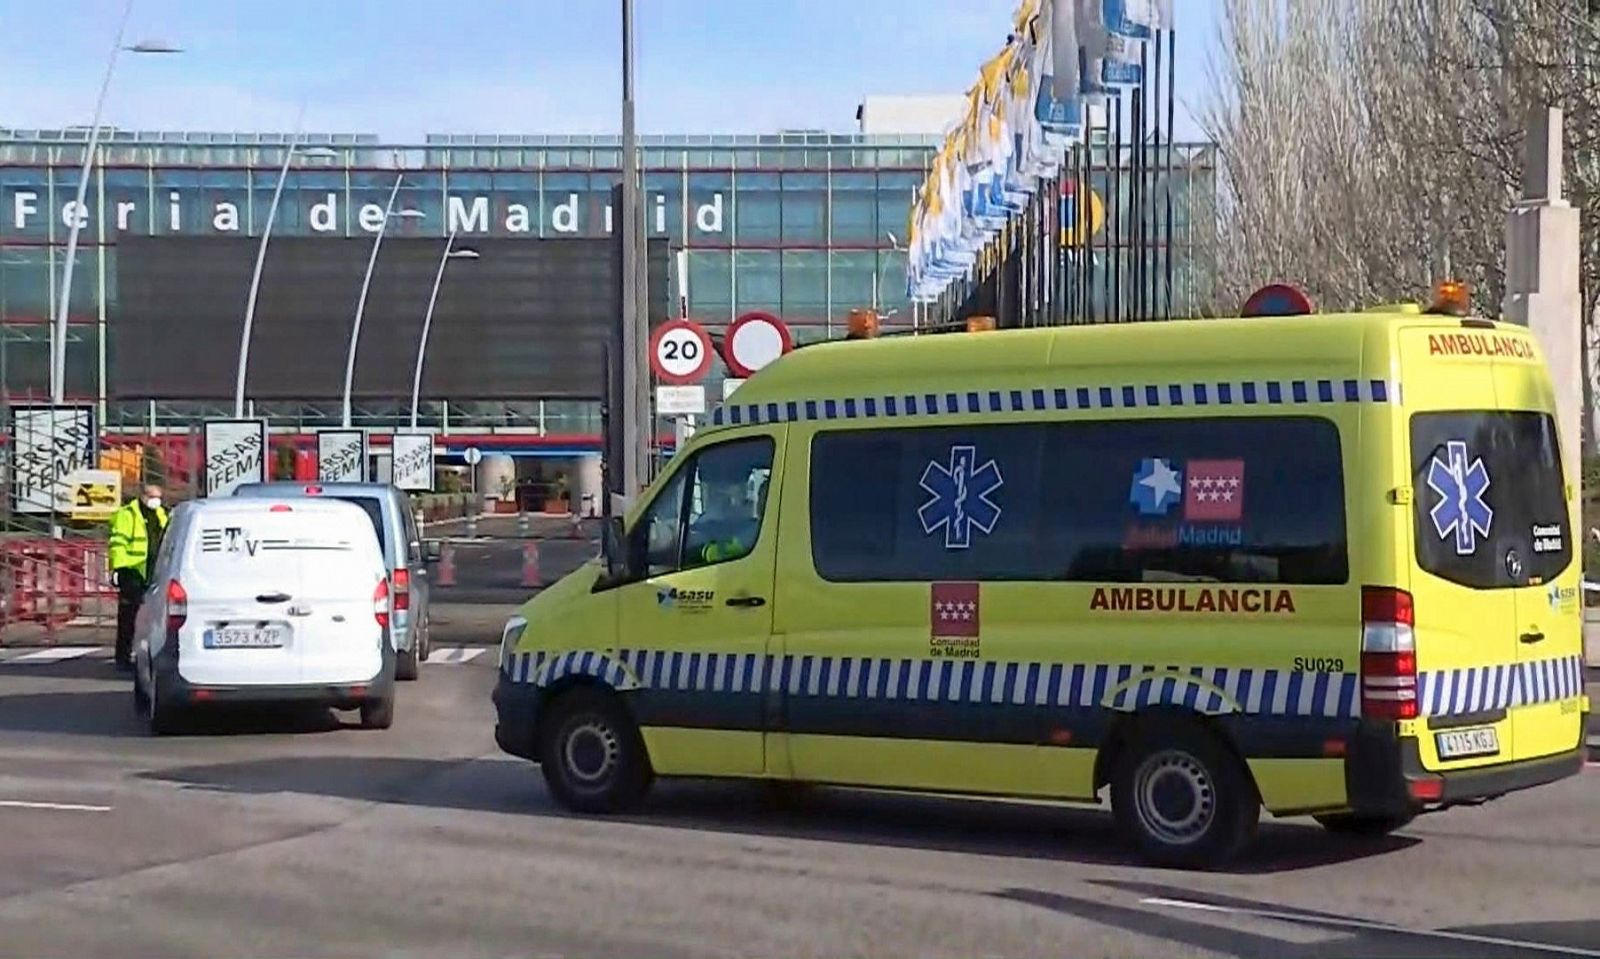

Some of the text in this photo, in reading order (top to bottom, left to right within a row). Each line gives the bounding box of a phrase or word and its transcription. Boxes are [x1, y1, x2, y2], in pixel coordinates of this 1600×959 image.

[14, 192, 239, 231] Feria
[310, 193, 384, 232] de
[664, 341, 697, 360] 20
[1428, 333, 1535, 360] AMBULANCIA
[1090, 588, 1295, 613] AMBULANCIA
[216, 629, 249, 644] 3573
[930, 638, 980, 647] Comunidad
[930, 647, 980, 658] de Madrid
[1294, 657, 1344, 672] SU029
[1447, 732, 1473, 751] 4115
